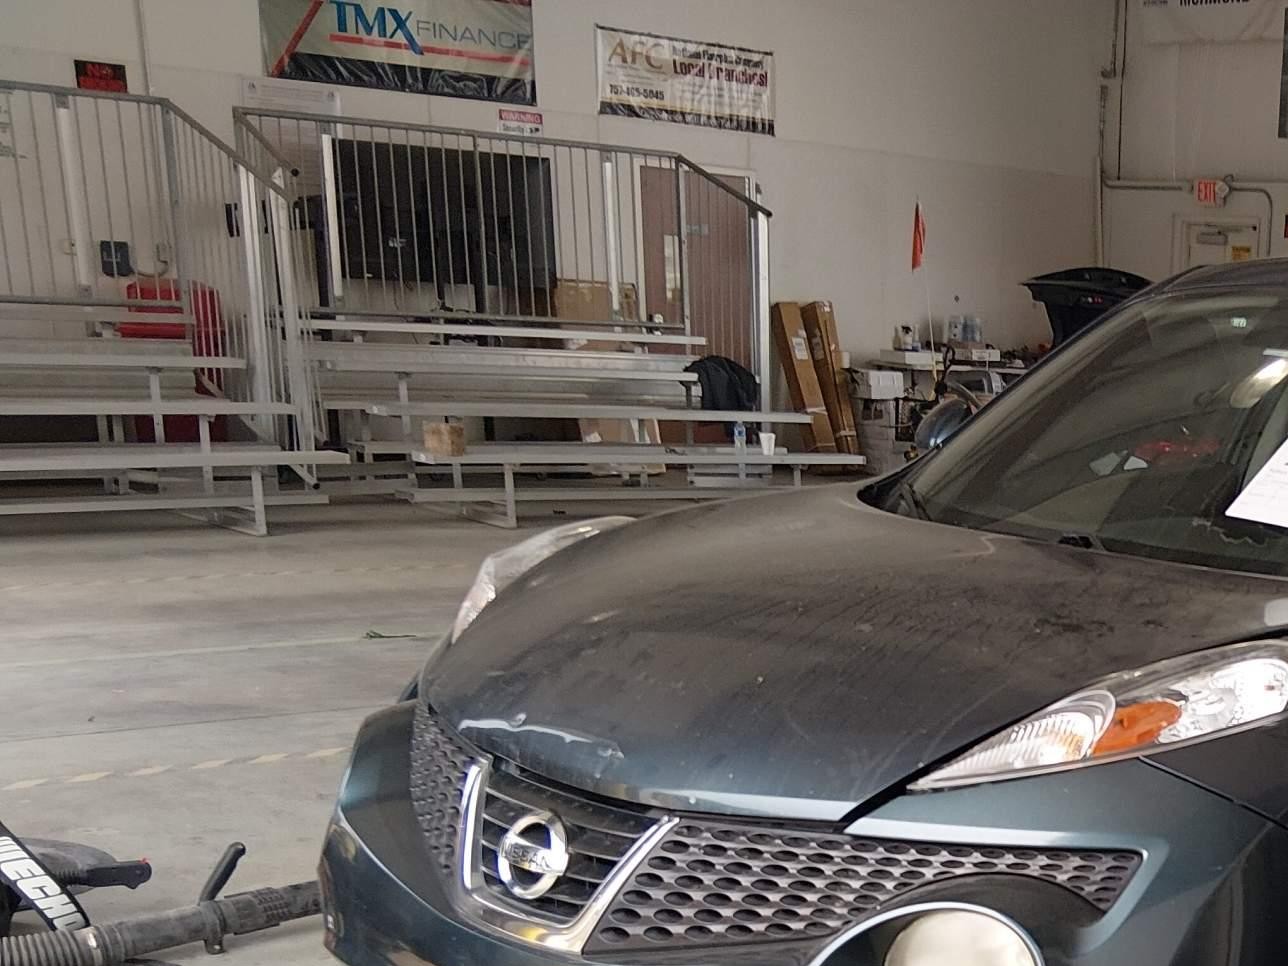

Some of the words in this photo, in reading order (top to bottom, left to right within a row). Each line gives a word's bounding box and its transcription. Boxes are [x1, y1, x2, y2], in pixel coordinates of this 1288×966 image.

[329, 0, 424, 55] TMX
[415, 19, 532, 50] FINANCE
[608, 37, 665, 70] AFC
[673, 58, 705, 78] Local
[501, 110, 541, 123] WARNING
[1198, 181, 1216, 202] EXIT
